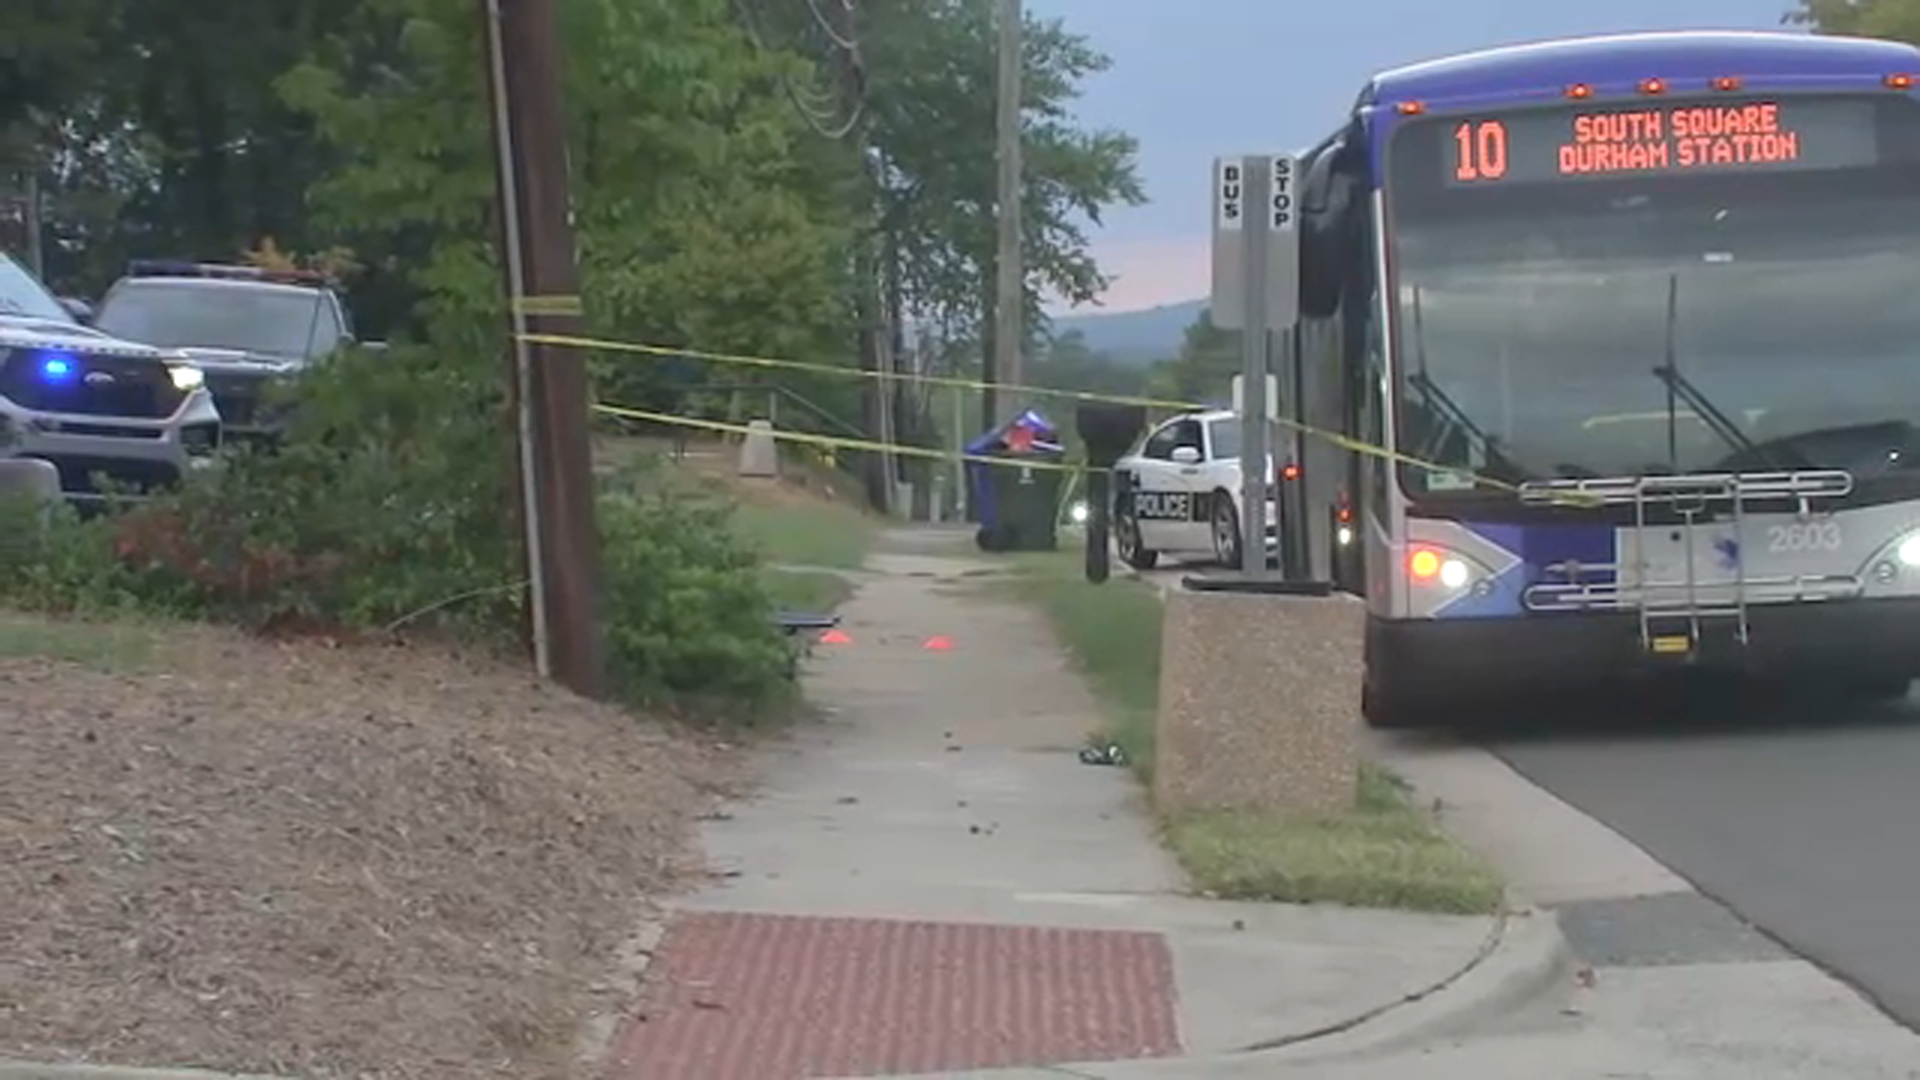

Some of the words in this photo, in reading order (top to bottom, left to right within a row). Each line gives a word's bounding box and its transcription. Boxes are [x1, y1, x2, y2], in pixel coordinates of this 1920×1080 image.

[1574, 111, 1662, 143] SOUTH
[1672, 104, 1779, 137] SQUARE
[1454, 120, 1507, 181] 10
[1559, 142, 1668, 173] DURHAM
[1677, 131, 1797, 166] STATION
[1224, 167, 1240, 218] BUS
[1274, 159, 1291, 225] STOP
[1136, 493, 1187, 517] POLICE
[1768, 522, 1842, 552] 2603
